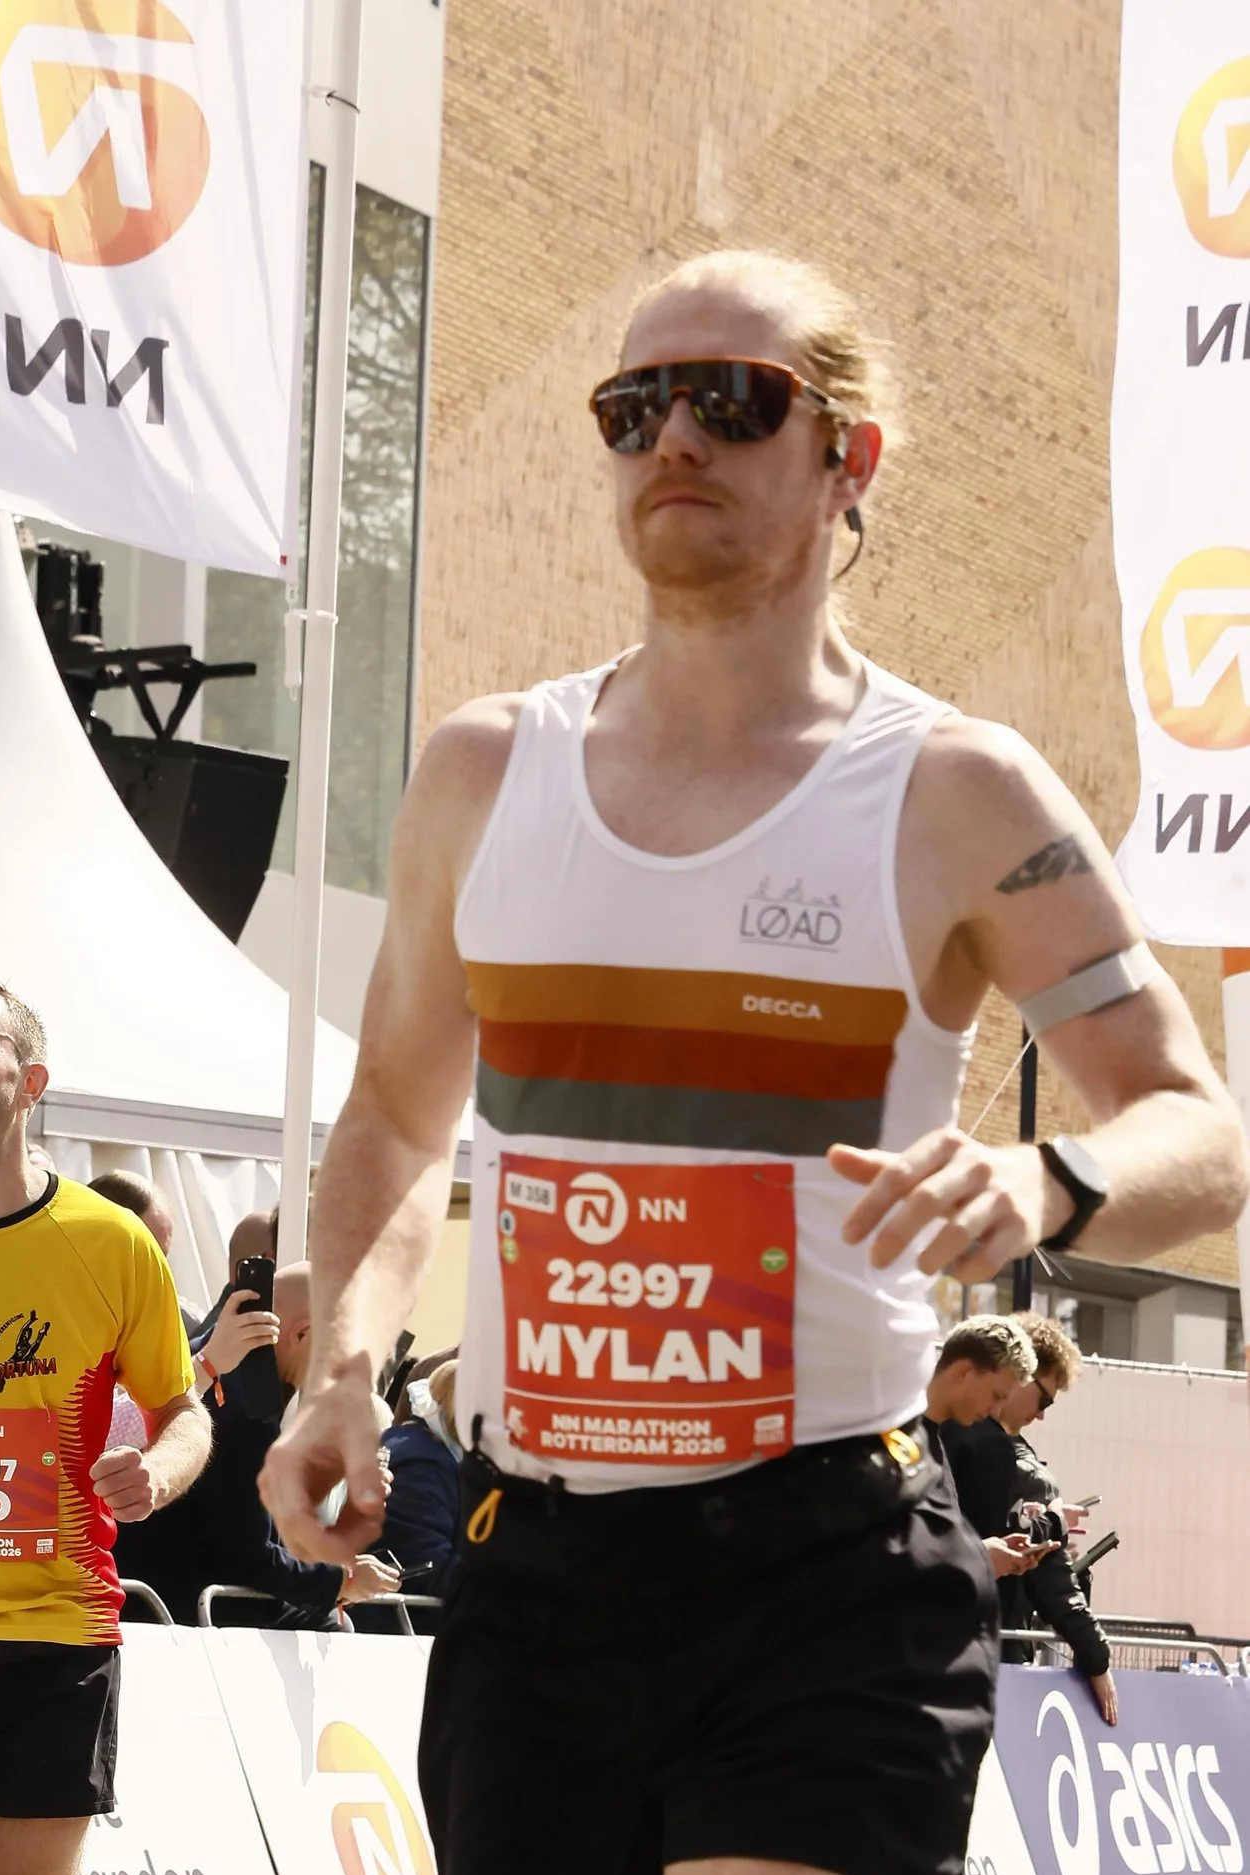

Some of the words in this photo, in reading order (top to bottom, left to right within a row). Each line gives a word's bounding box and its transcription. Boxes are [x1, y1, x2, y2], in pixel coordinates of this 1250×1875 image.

[742, 995, 823, 1021] DECCA
[638, 1197, 687, 1223] NN
[546, 1257, 713, 1309] 22997
[516, 1317, 763, 1383] MYLAN
[551, 1414, 580, 1433] NN
[583, 1417, 711, 1437] MARATHON
[540, 1430, 668, 1454] ROTTERDAM
[673, 1436, 726, 1455] 2026
[1097, 1742, 1244, 1874] asics
